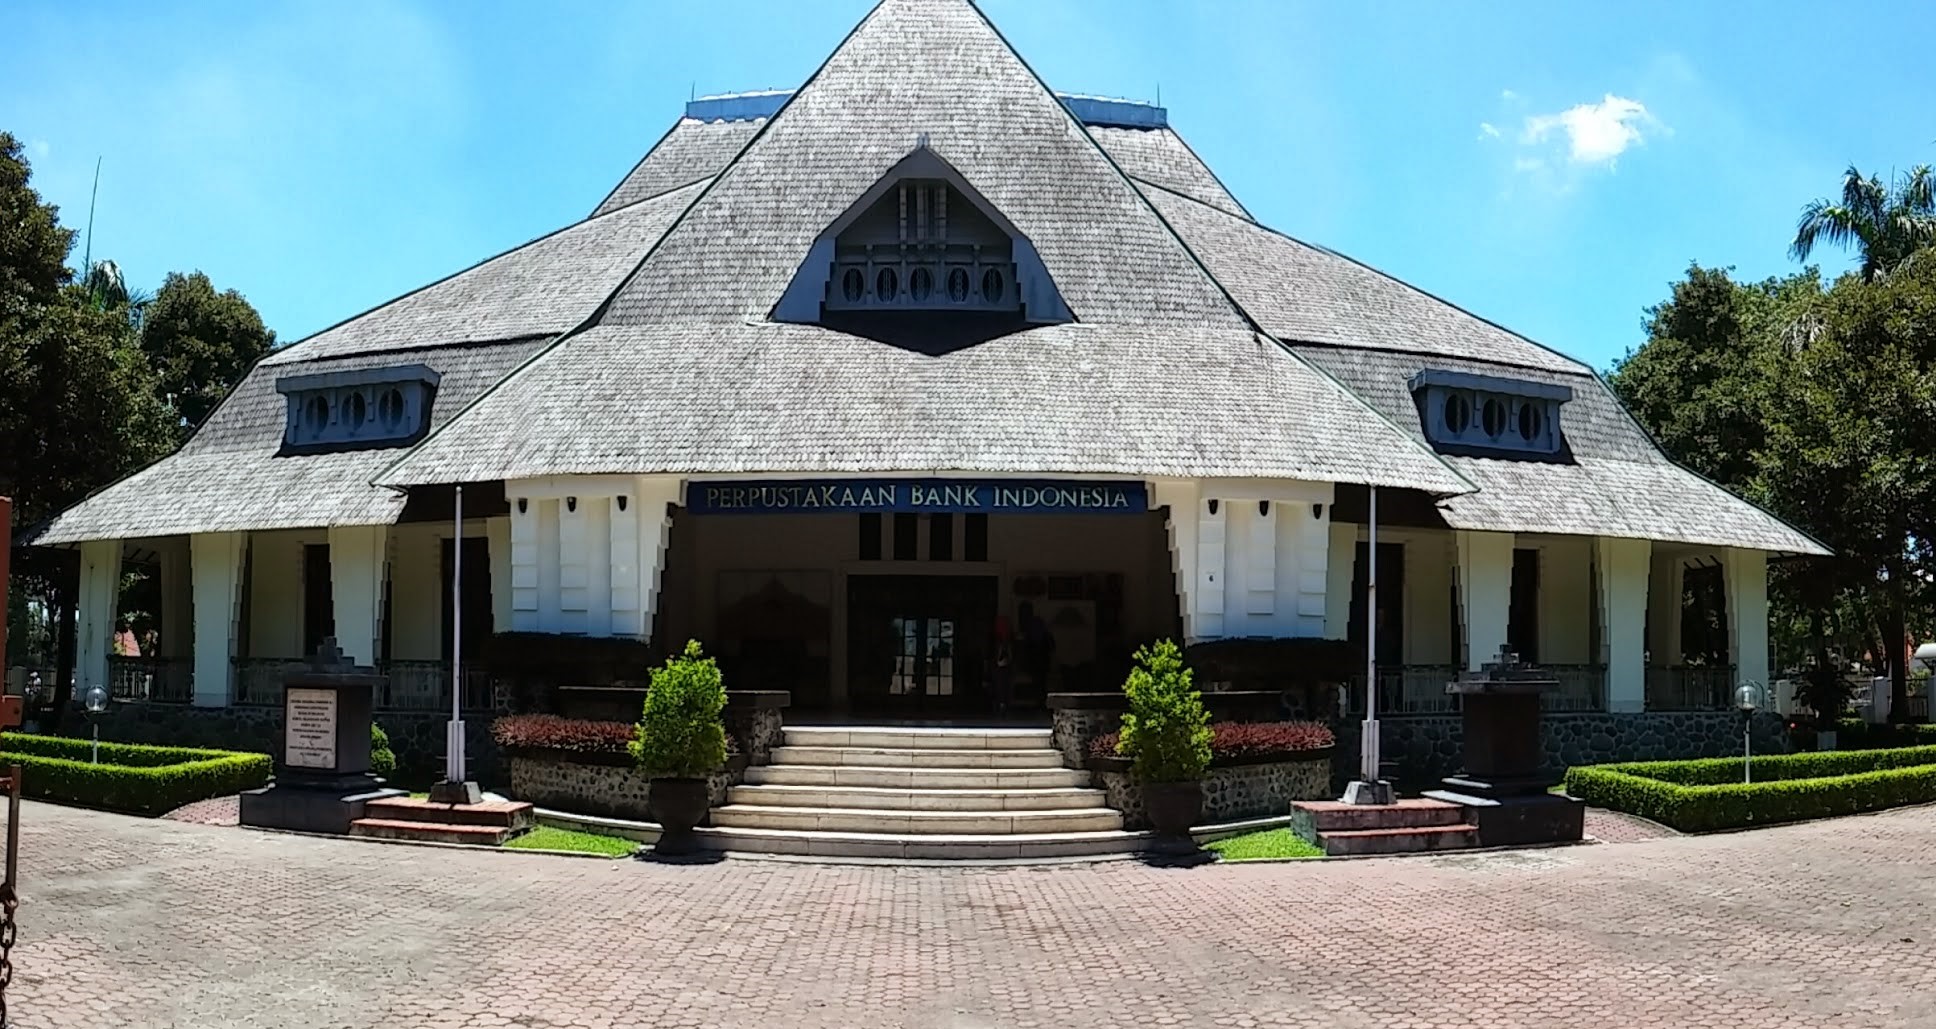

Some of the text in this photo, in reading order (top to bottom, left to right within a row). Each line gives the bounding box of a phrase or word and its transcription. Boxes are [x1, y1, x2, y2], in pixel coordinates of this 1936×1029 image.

[706, 485, 1129, 508] PERPUSTAKAAN BANK INDONESIA
